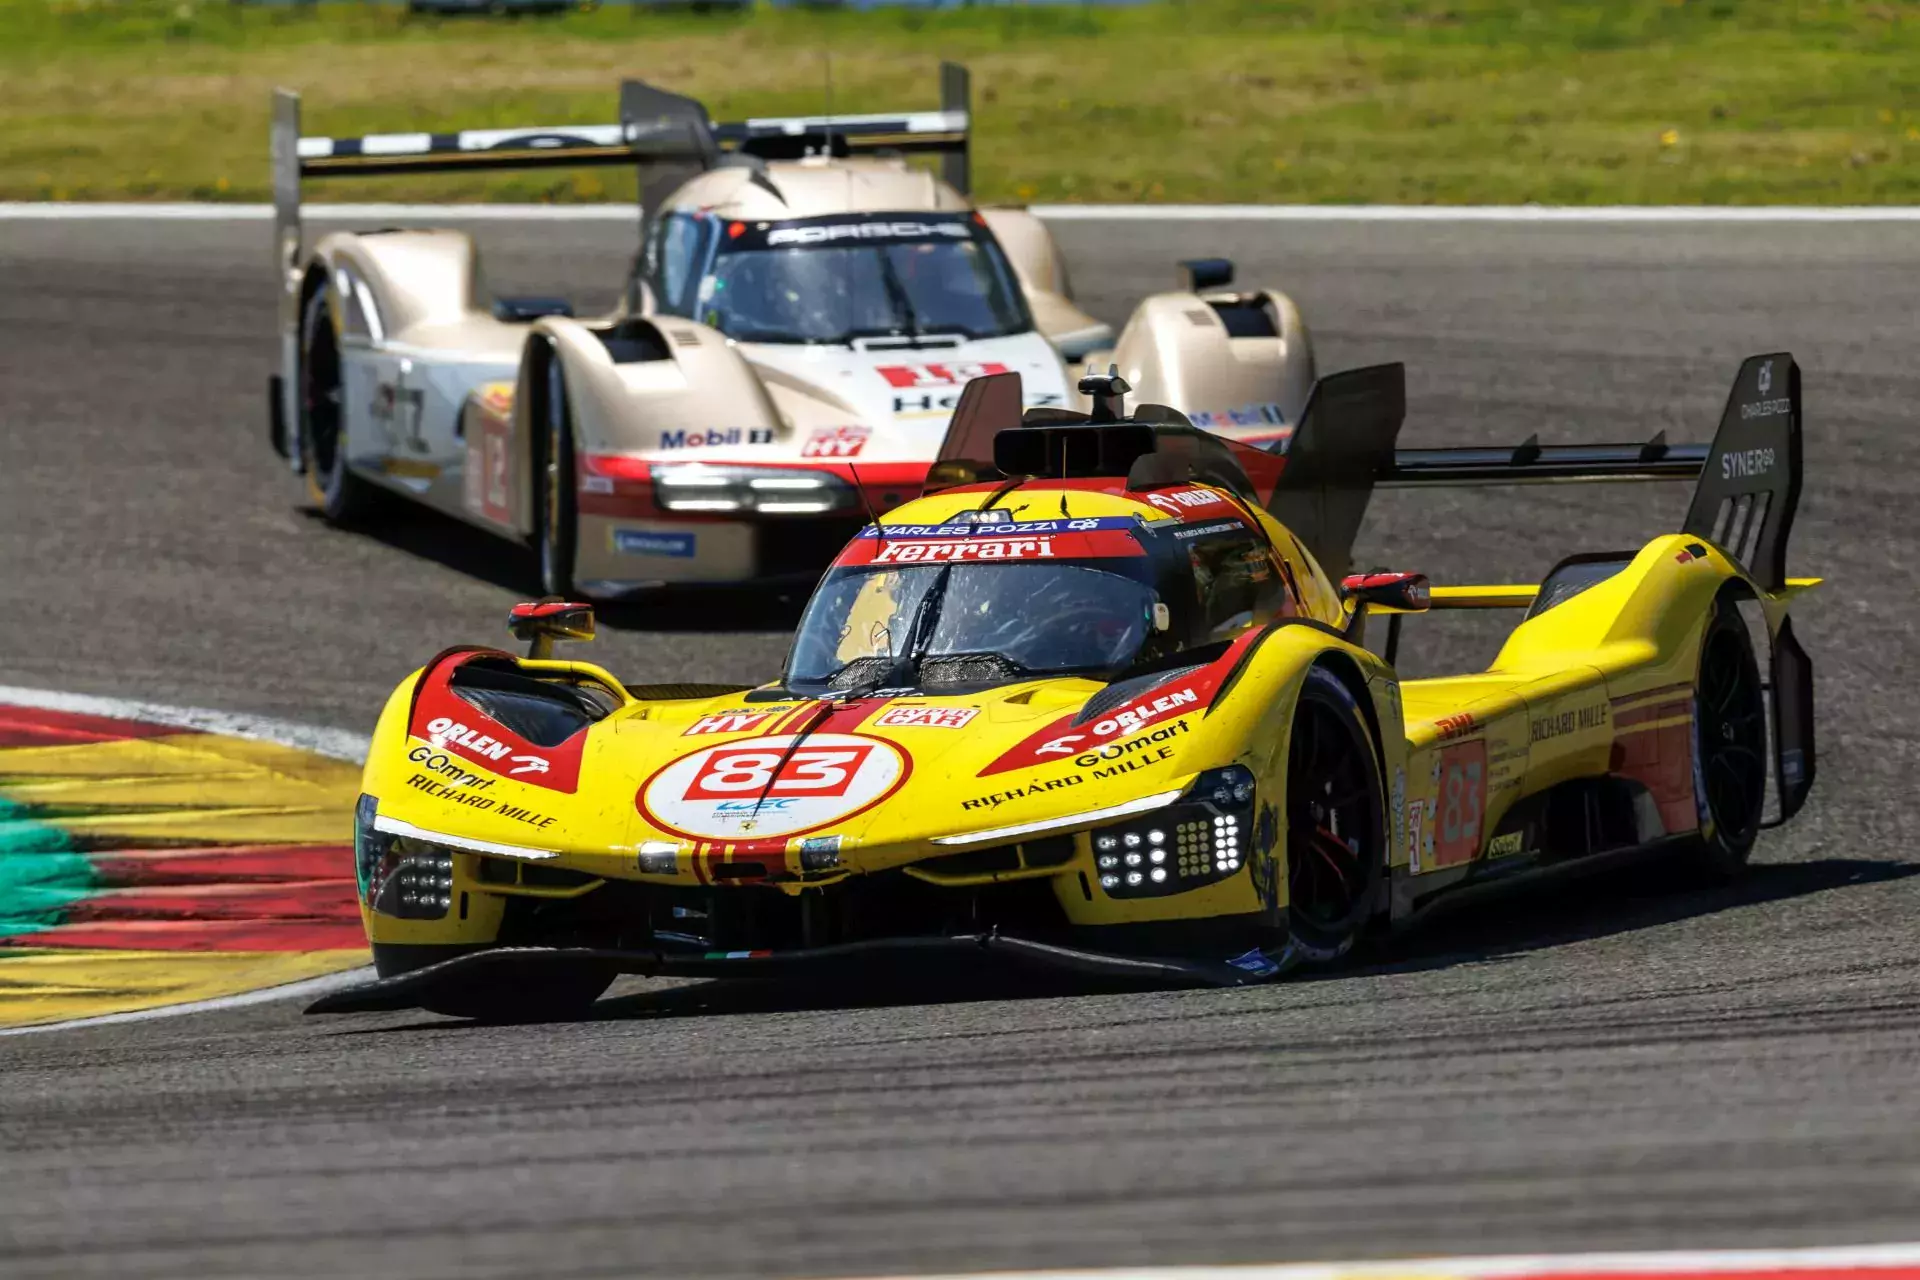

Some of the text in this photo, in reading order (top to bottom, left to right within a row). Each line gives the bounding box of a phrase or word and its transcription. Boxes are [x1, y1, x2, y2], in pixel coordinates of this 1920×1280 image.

[767, 222, 971, 245] PORSCHE
[660, 428, 741, 450] Mobil
[864, 524, 971, 537] CHARLES
[977, 521, 1059, 534] POZZI
[870, 535, 1057, 564] Ferrari
[687, 713, 769, 735] HY
[884, 714, 963, 726] CAR
[1092, 688, 1198, 735] ORLEN
[1531, 703, 1608, 743] RICHARD MILLE
[427, 717, 513, 761] ORLEN
[700, 751, 859, 792] 83
[961, 746, 1176, 811] RICHARD MILLE
[407, 773, 558, 829] RICHARD MILLE
[715, 798, 802, 811] WEC
[1443, 762, 1482, 843] 83
